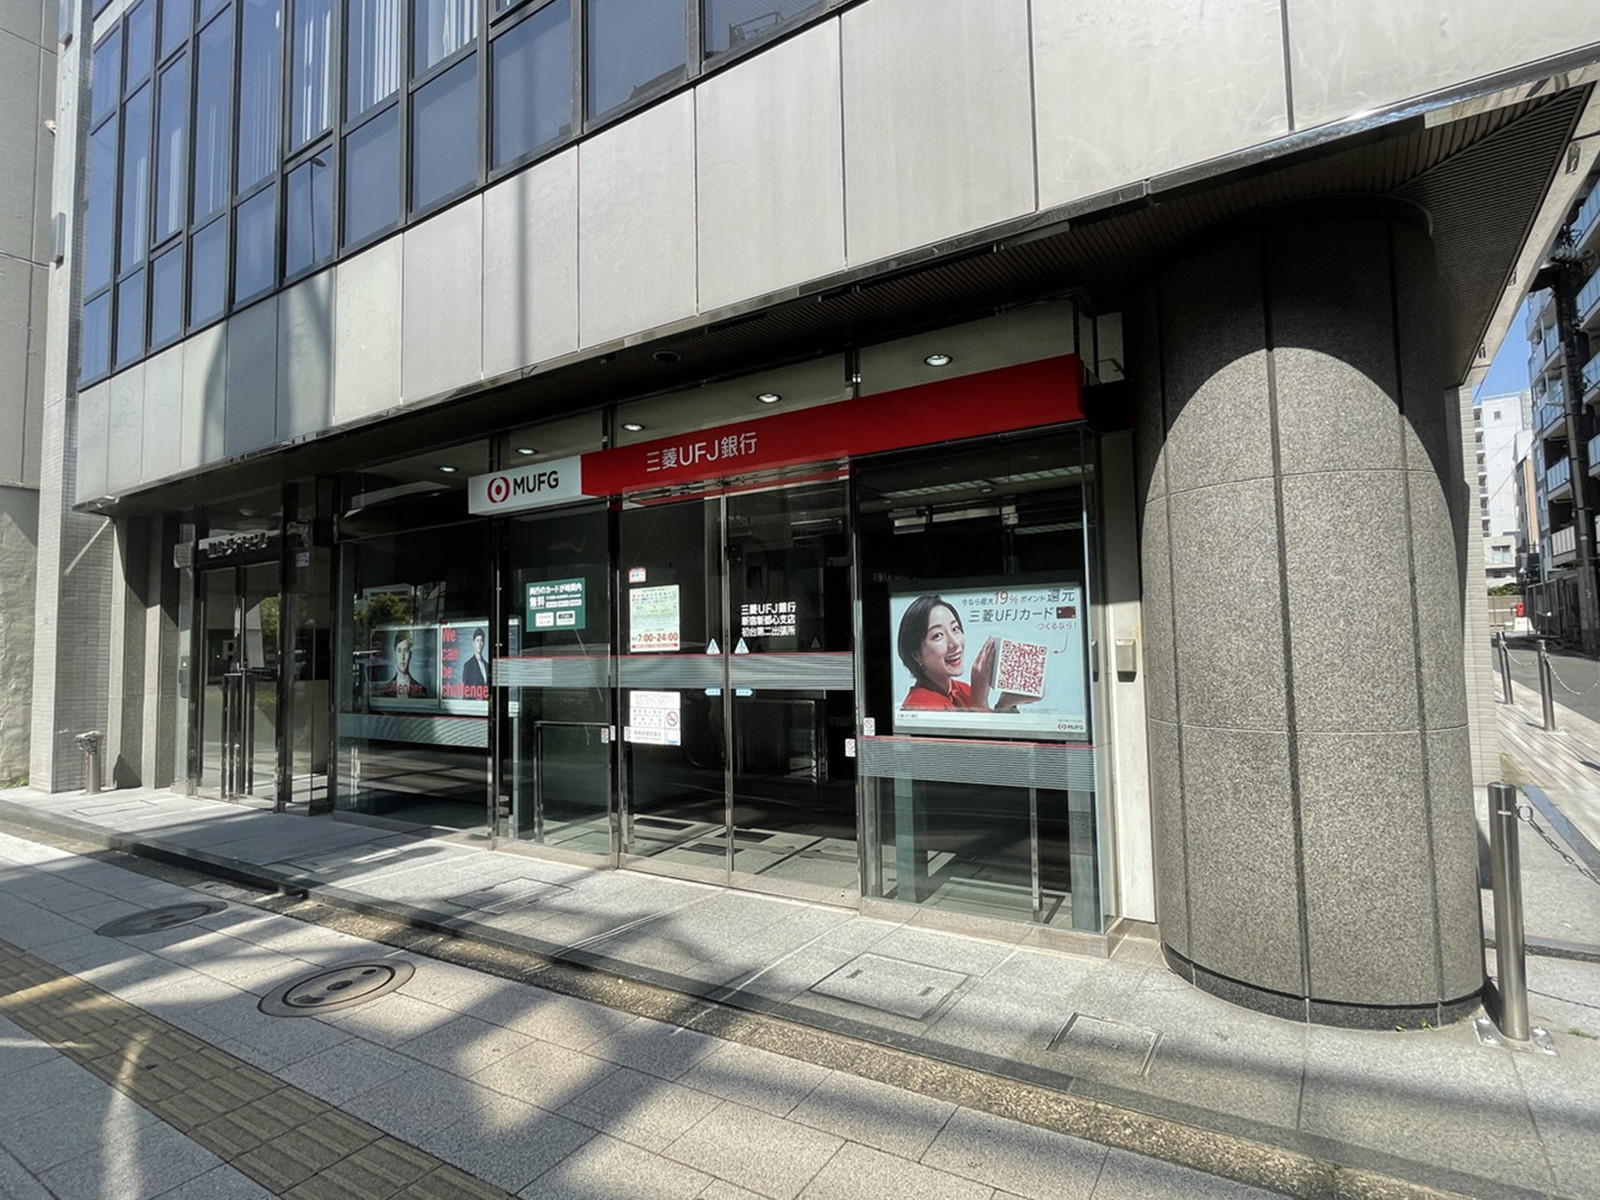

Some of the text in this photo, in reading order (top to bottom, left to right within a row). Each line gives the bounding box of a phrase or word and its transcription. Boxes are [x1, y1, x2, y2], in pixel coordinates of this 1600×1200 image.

[646, 432, 757, 472] 三菱UFJ銀行
[513, 471, 559, 496] MUFG
[741, 601, 796, 615] 三菱UFJ銀行
[968, 606, 1054, 623] 三菱UFJカード
[442, 628, 457, 643] We
[442, 648, 460, 661] can
[442, 665, 454, 679] be
[442, 682, 489, 701] challenge
